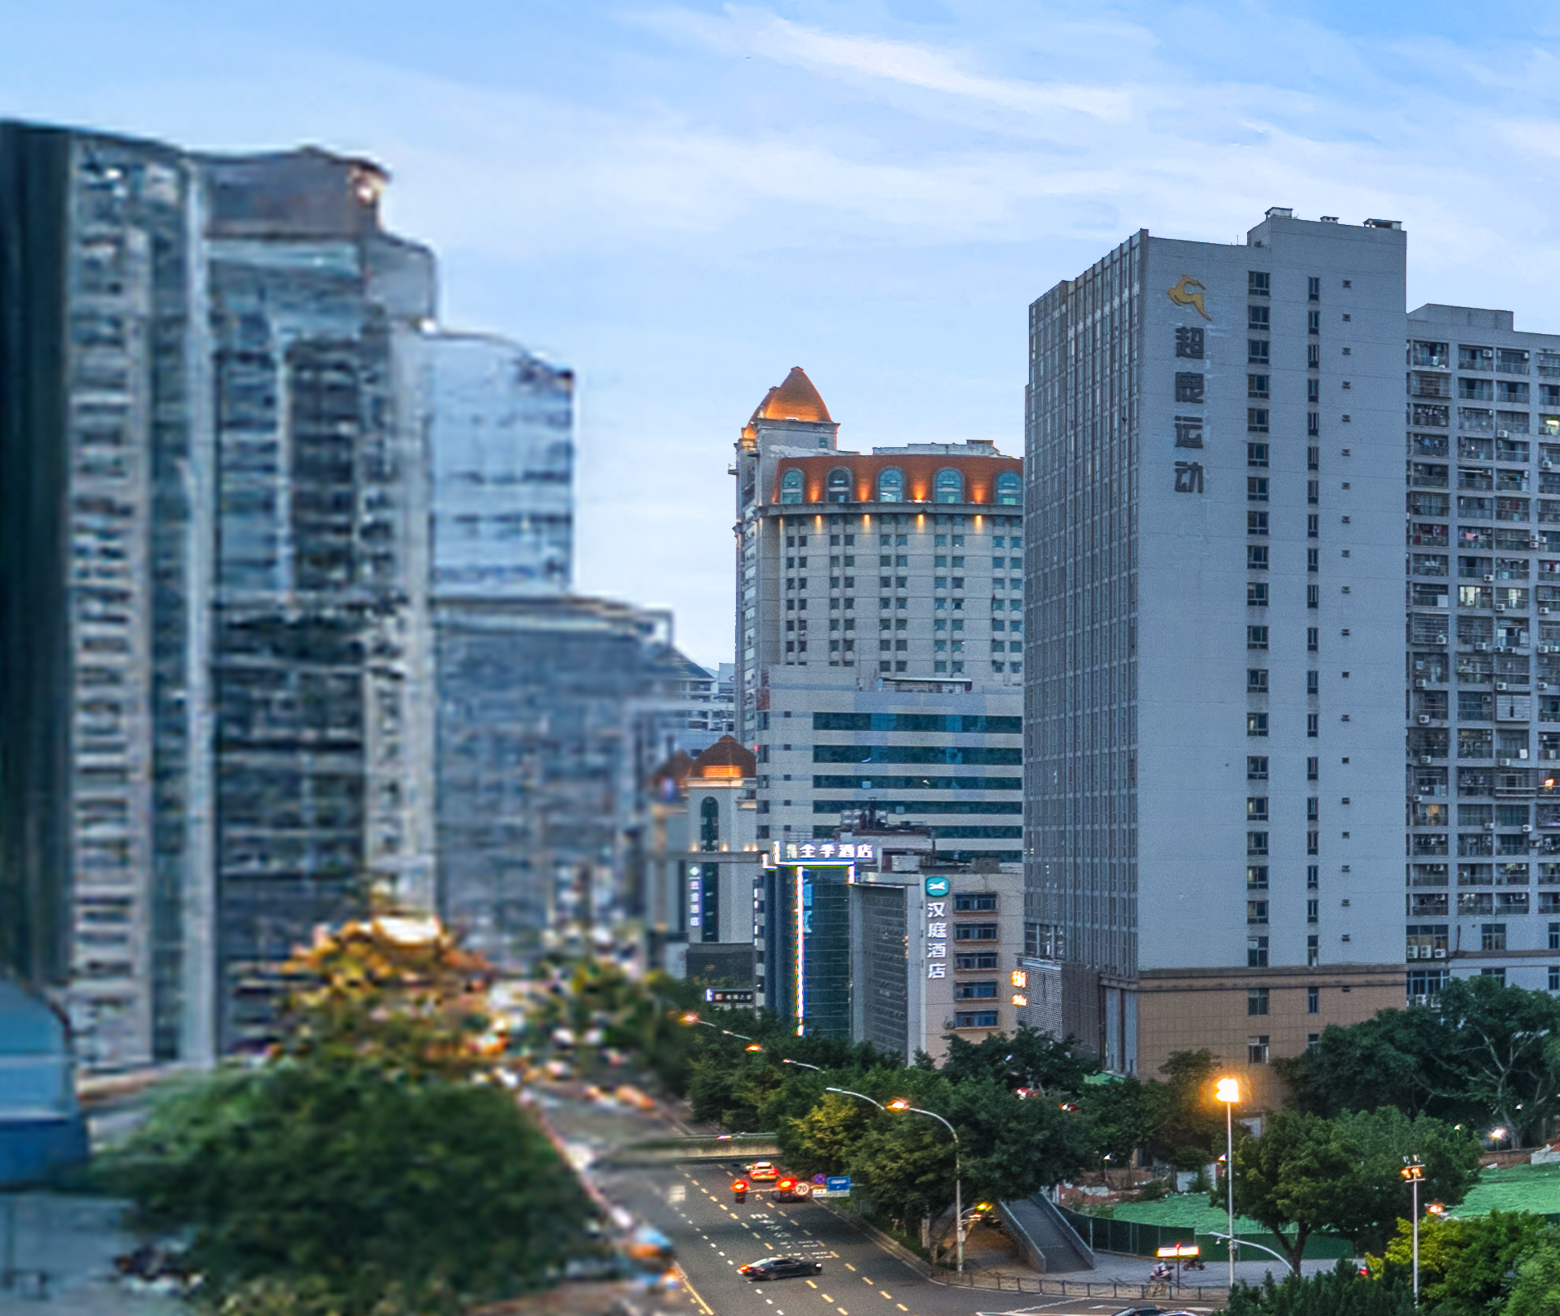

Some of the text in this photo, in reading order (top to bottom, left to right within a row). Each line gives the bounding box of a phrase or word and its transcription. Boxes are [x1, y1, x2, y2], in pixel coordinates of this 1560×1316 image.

[800, 843, 872, 859] 全季酒店
[927, 901, 947, 979] 汉庭酒店
